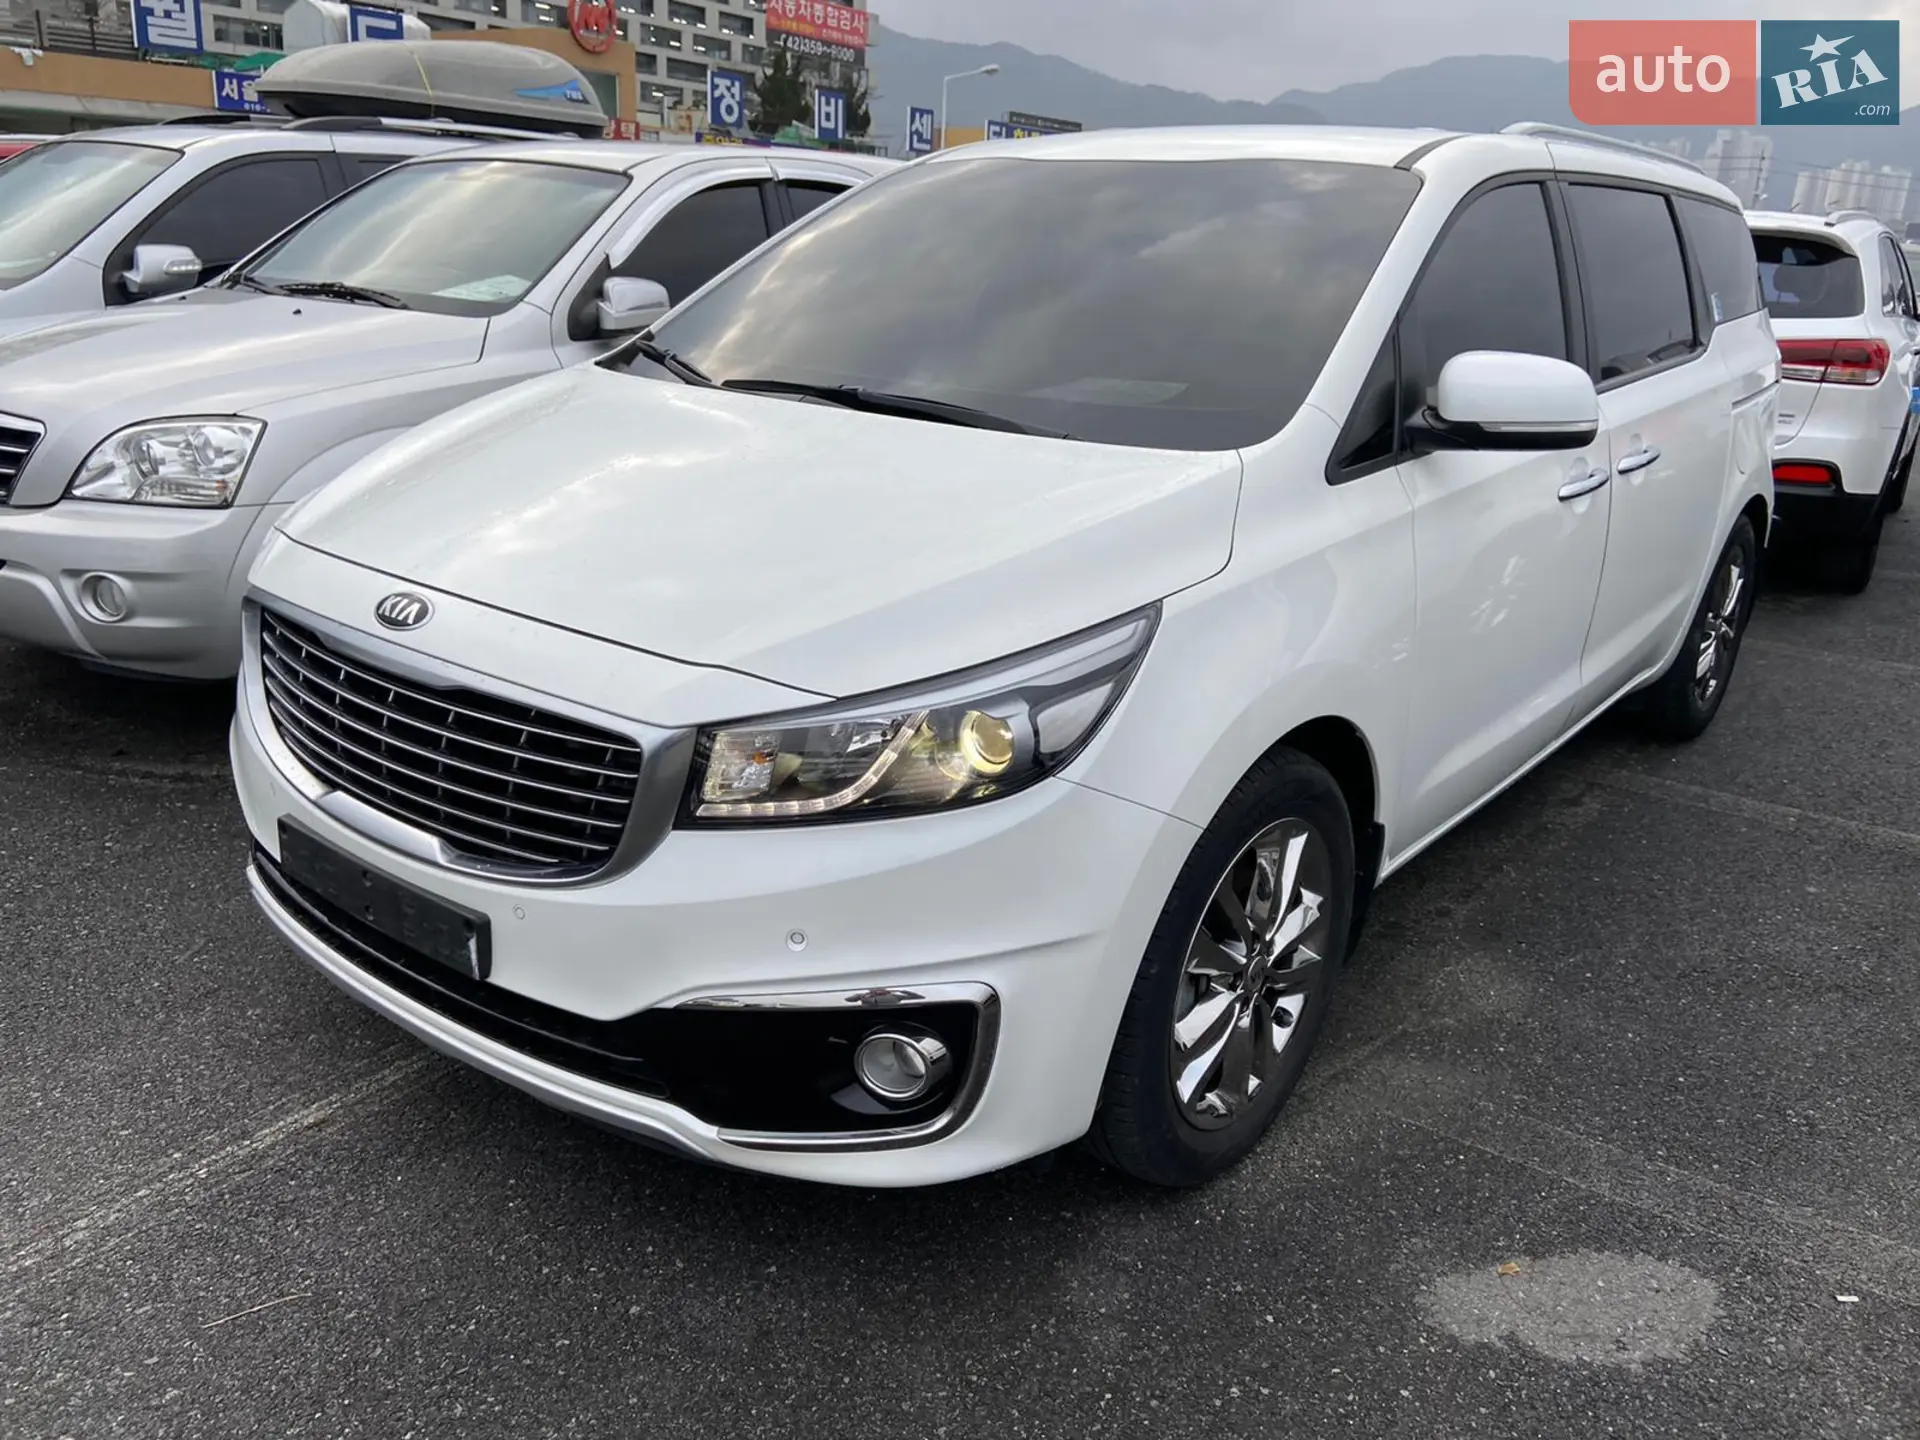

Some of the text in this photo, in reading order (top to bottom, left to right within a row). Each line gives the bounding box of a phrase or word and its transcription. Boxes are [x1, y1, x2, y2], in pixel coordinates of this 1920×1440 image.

[713, 76, 741, 125] 정
[820, 96, 844, 139] 비
[911, 113, 932, 149] 센
[378, 595, 422, 625] KIA
